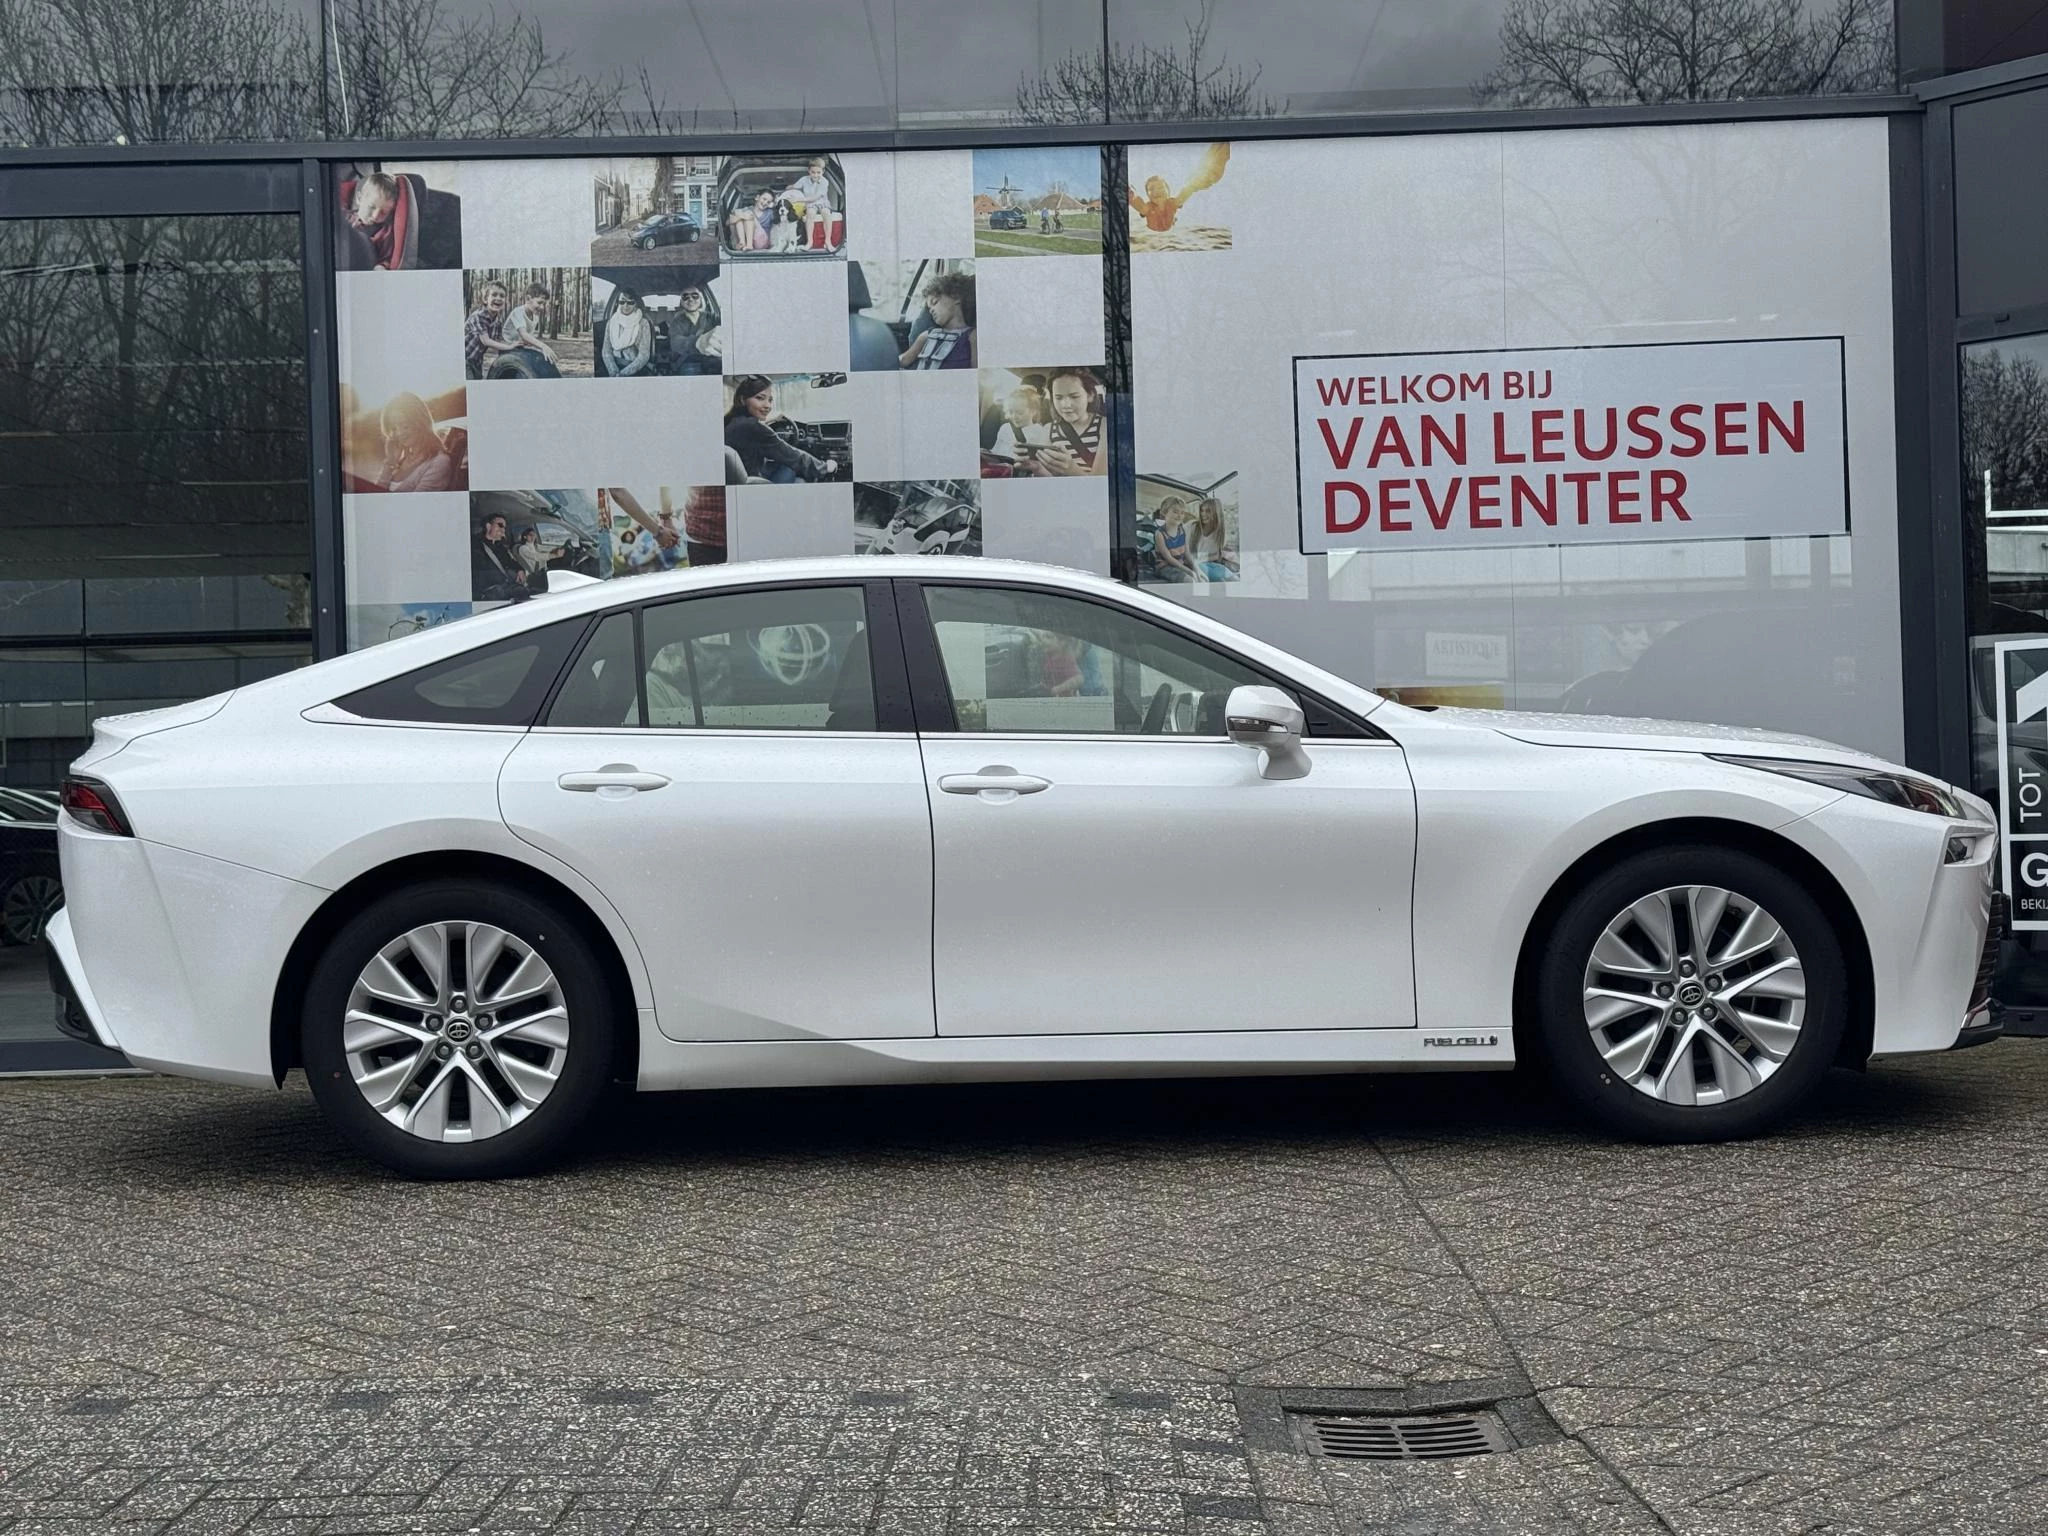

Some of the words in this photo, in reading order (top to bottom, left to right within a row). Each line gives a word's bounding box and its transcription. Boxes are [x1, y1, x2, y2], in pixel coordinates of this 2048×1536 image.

[1317, 371, 1490, 406] WELKOM
[1503, 369, 1553, 399] BIJ
[1318, 412, 1467, 469] VAN
[1494, 400, 1805, 464] LEUSSEN
[1324, 469, 1693, 534] DEVENTER
[2018, 767, 2042, 823] TOT
